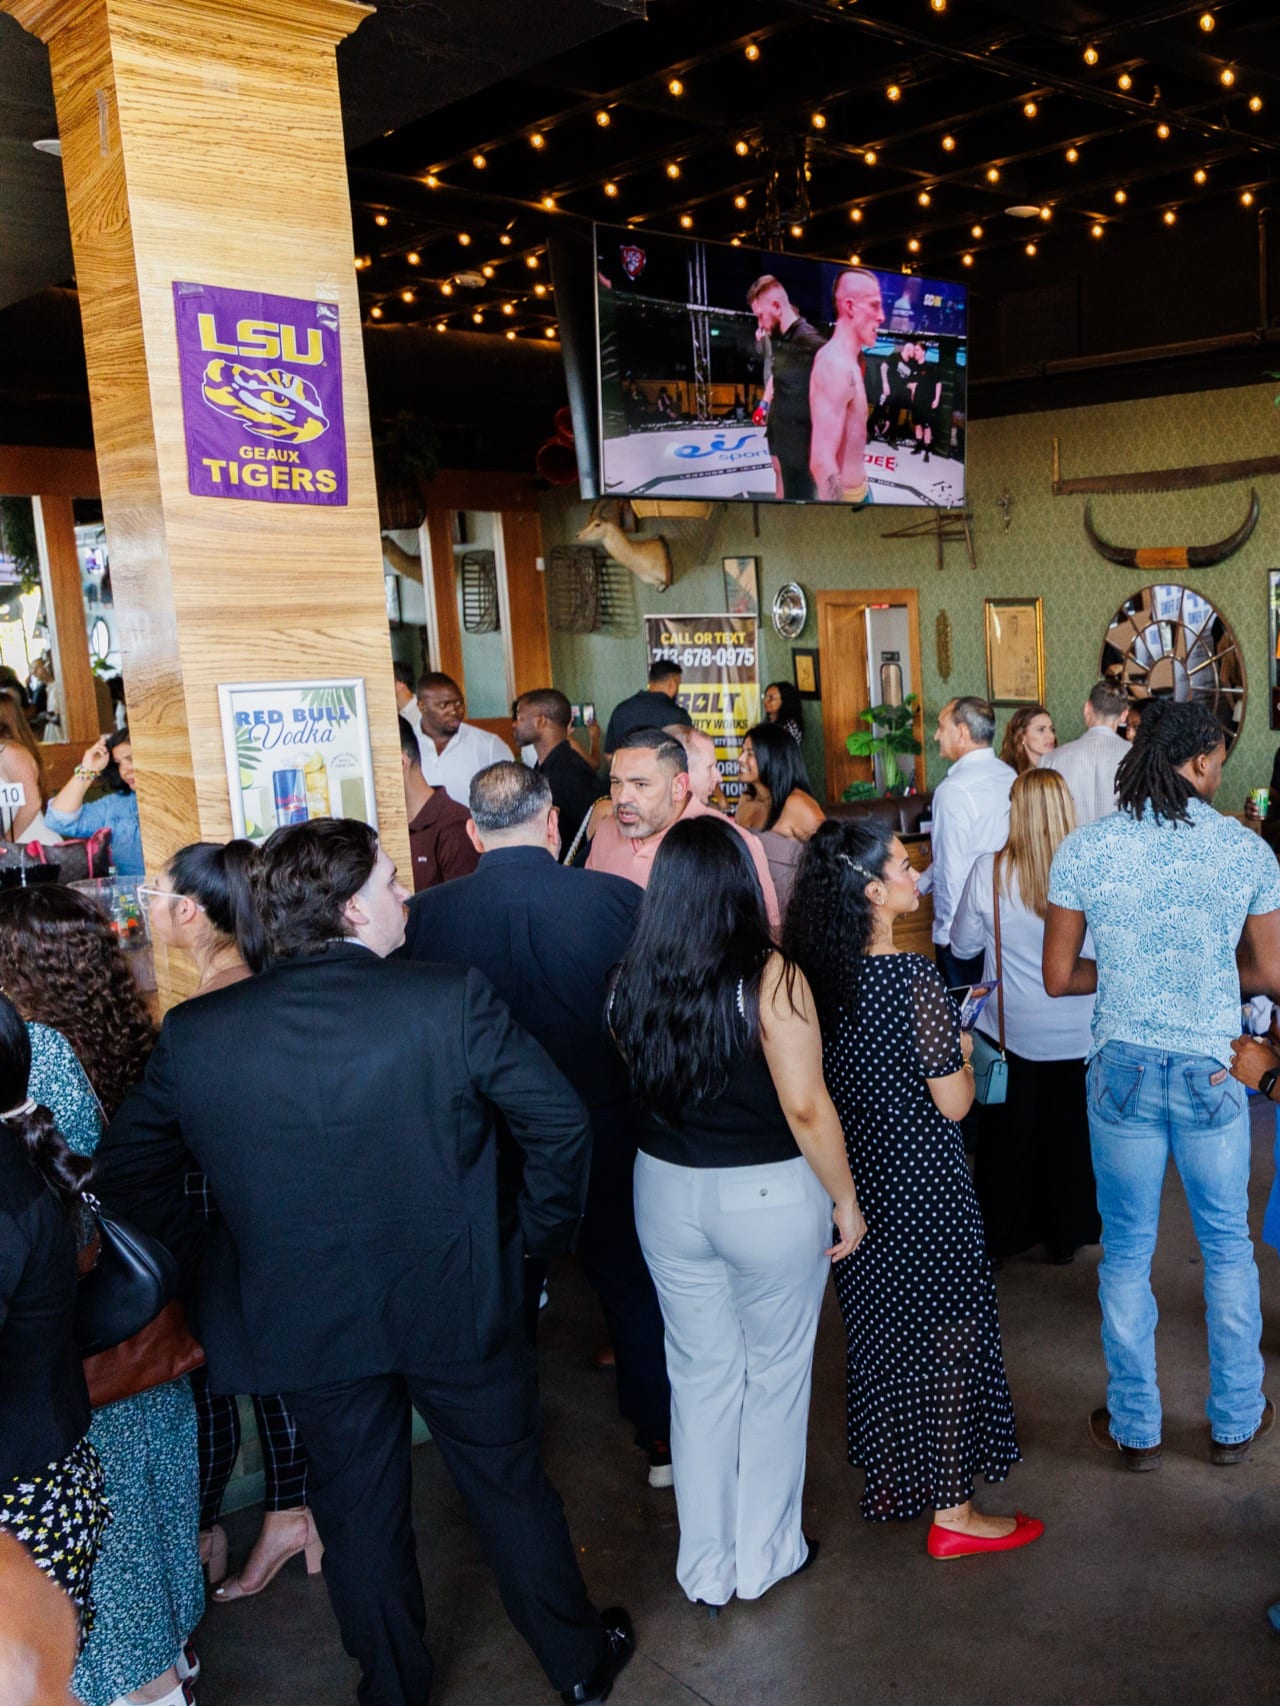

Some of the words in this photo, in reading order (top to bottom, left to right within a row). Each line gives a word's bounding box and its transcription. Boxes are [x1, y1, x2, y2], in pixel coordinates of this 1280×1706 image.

[198, 313, 324, 366] LSU
[239, 445, 300, 463] GEAUX
[202, 458, 337, 493] TIGERS
[661, 632, 693, 645] CALL
[694, 632, 712, 645] OR
[714, 632, 746, 645] TEXT
[652, 647, 755, 668] 713-678-0975
[235, 709, 284, 727] RED
[292, 705, 351, 723] BULL
[713, 719, 748, 730] WORKS
[248, 720, 335, 750] Vodka
[2, 787, 20, 803] 10
